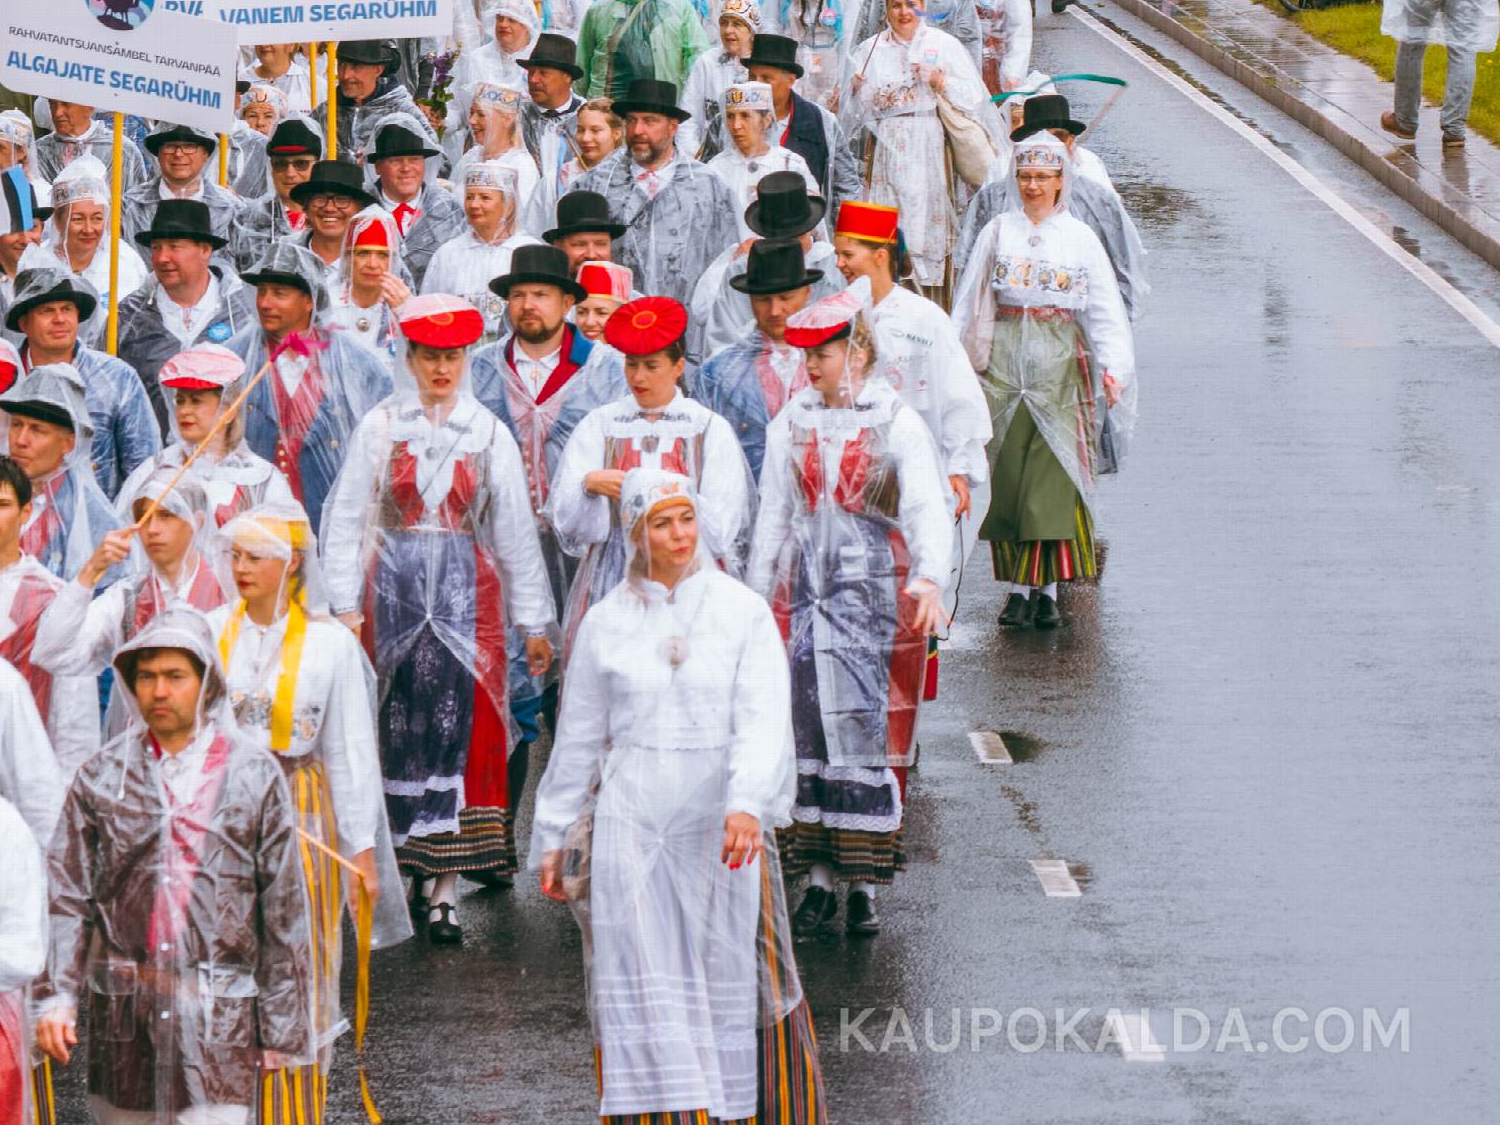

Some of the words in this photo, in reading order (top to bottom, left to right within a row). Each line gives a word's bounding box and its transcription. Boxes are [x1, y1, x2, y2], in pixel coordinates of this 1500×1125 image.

[219, 4, 304, 26] VANEM
[8, 25, 152, 64] RAHVATANTSUANSAMBEL
[154, 53, 221, 77] TARVANPÄÄ
[6, 50, 106, 85] ALGAJATE
[109, 69, 222, 109] SEGARÜHM
